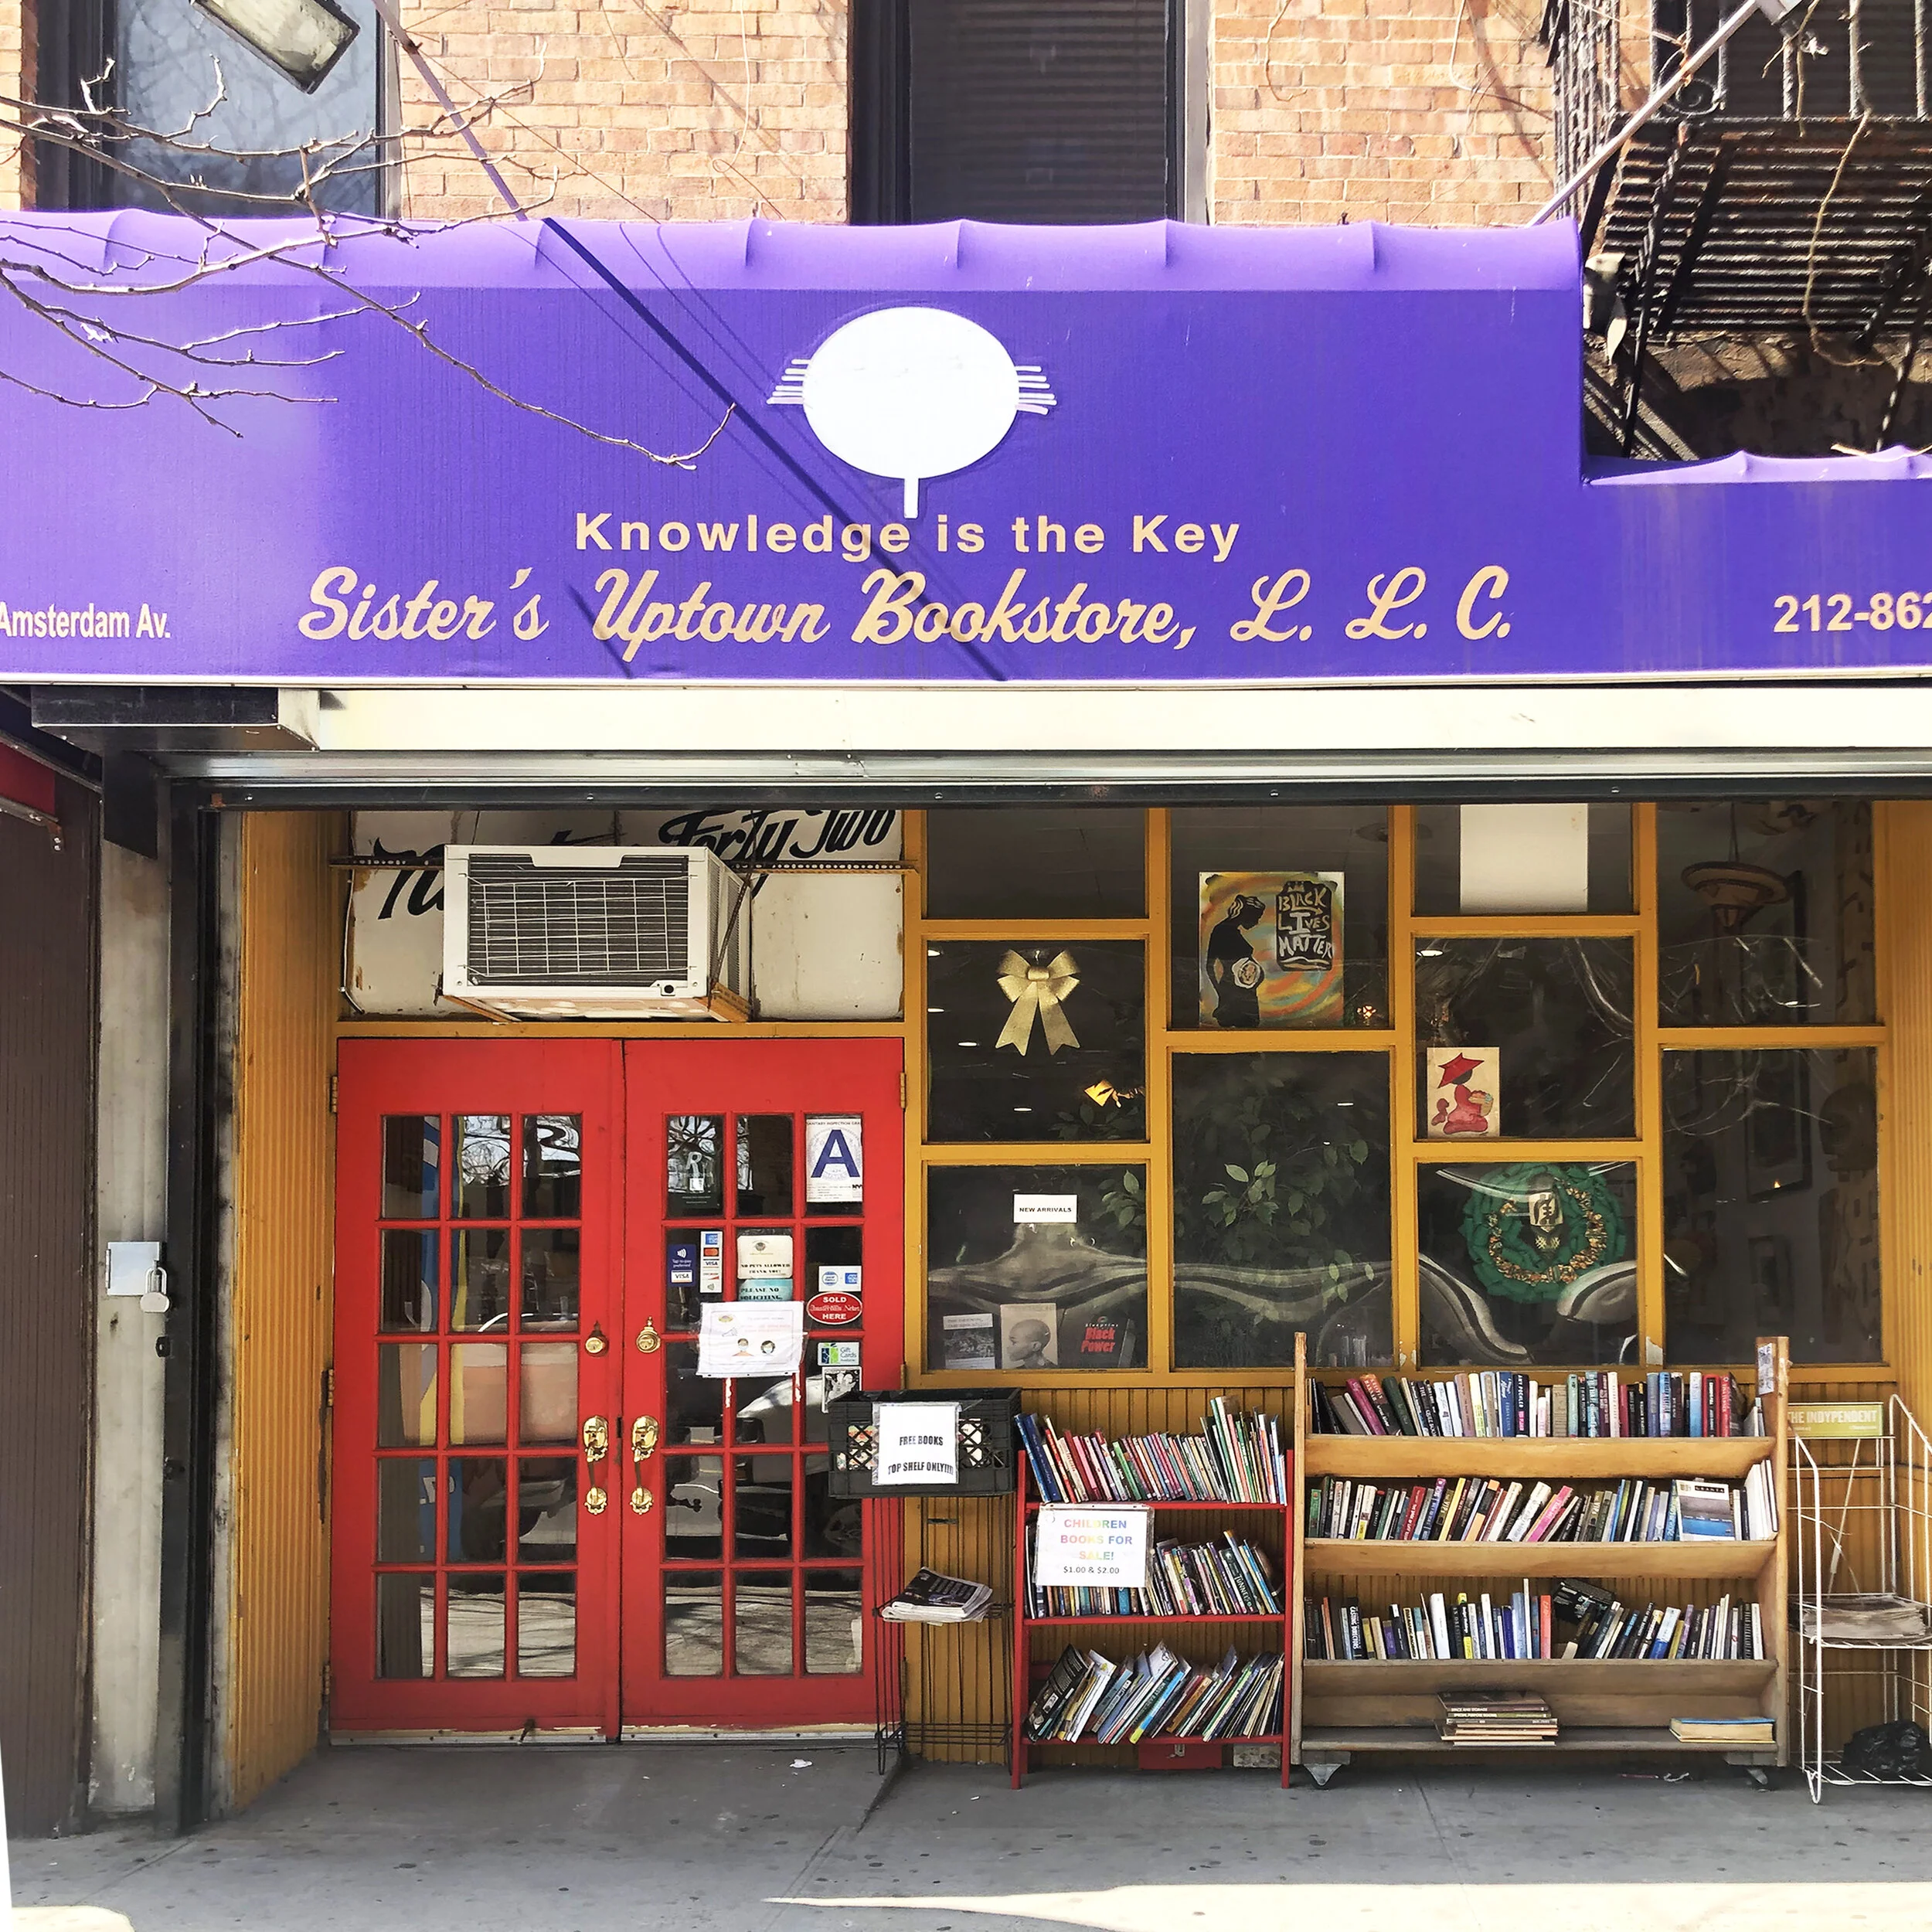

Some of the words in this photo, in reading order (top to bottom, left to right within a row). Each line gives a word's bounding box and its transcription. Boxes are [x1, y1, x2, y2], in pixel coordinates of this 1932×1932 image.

[576, 514, 910, 563] Knowledge
[937, 515, 985, 553] is
[1012, 515, 1105, 553] the
[1132, 514, 1240, 563] Key
[0, 602, 130, 638] Amsterdam
[136, 603, 171, 638] Av.
[298, 566, 549, 641] Sister's
[592, 568, 831, 662] Uptown
[852, 568, 1197, 650] Bookstore,
[1230, 568, 1311, 642] L.
[1345, 566, 1427, 641] L.
[1456, 565, 1511, 641] C.
[1278, 888, 1327, 911] BLACK
[1278, 912, 1330, 935] LIVES
[1278, 934, 1334, 959] MATTER
[811, 1129, 860, 1178] A
[1085, 1327, 1116, 1340] Black
[1080, 1339, 1116, 1353] Power
[899, 1435, 917, 1446] FREE
[917, 1435, 944, 1446] BOOKS
[888, 1463, 902, 1475] TOP
[903, 1461, 925, 1472] SHELF
[1064, 1519, 1127, 1529] CHILDREN
[1060, 1535, 1104, 1544] BOOKS
[1108, 1536, 1133, 1545] FOR
[1079, 1551, 1114, 1560] SALE!
